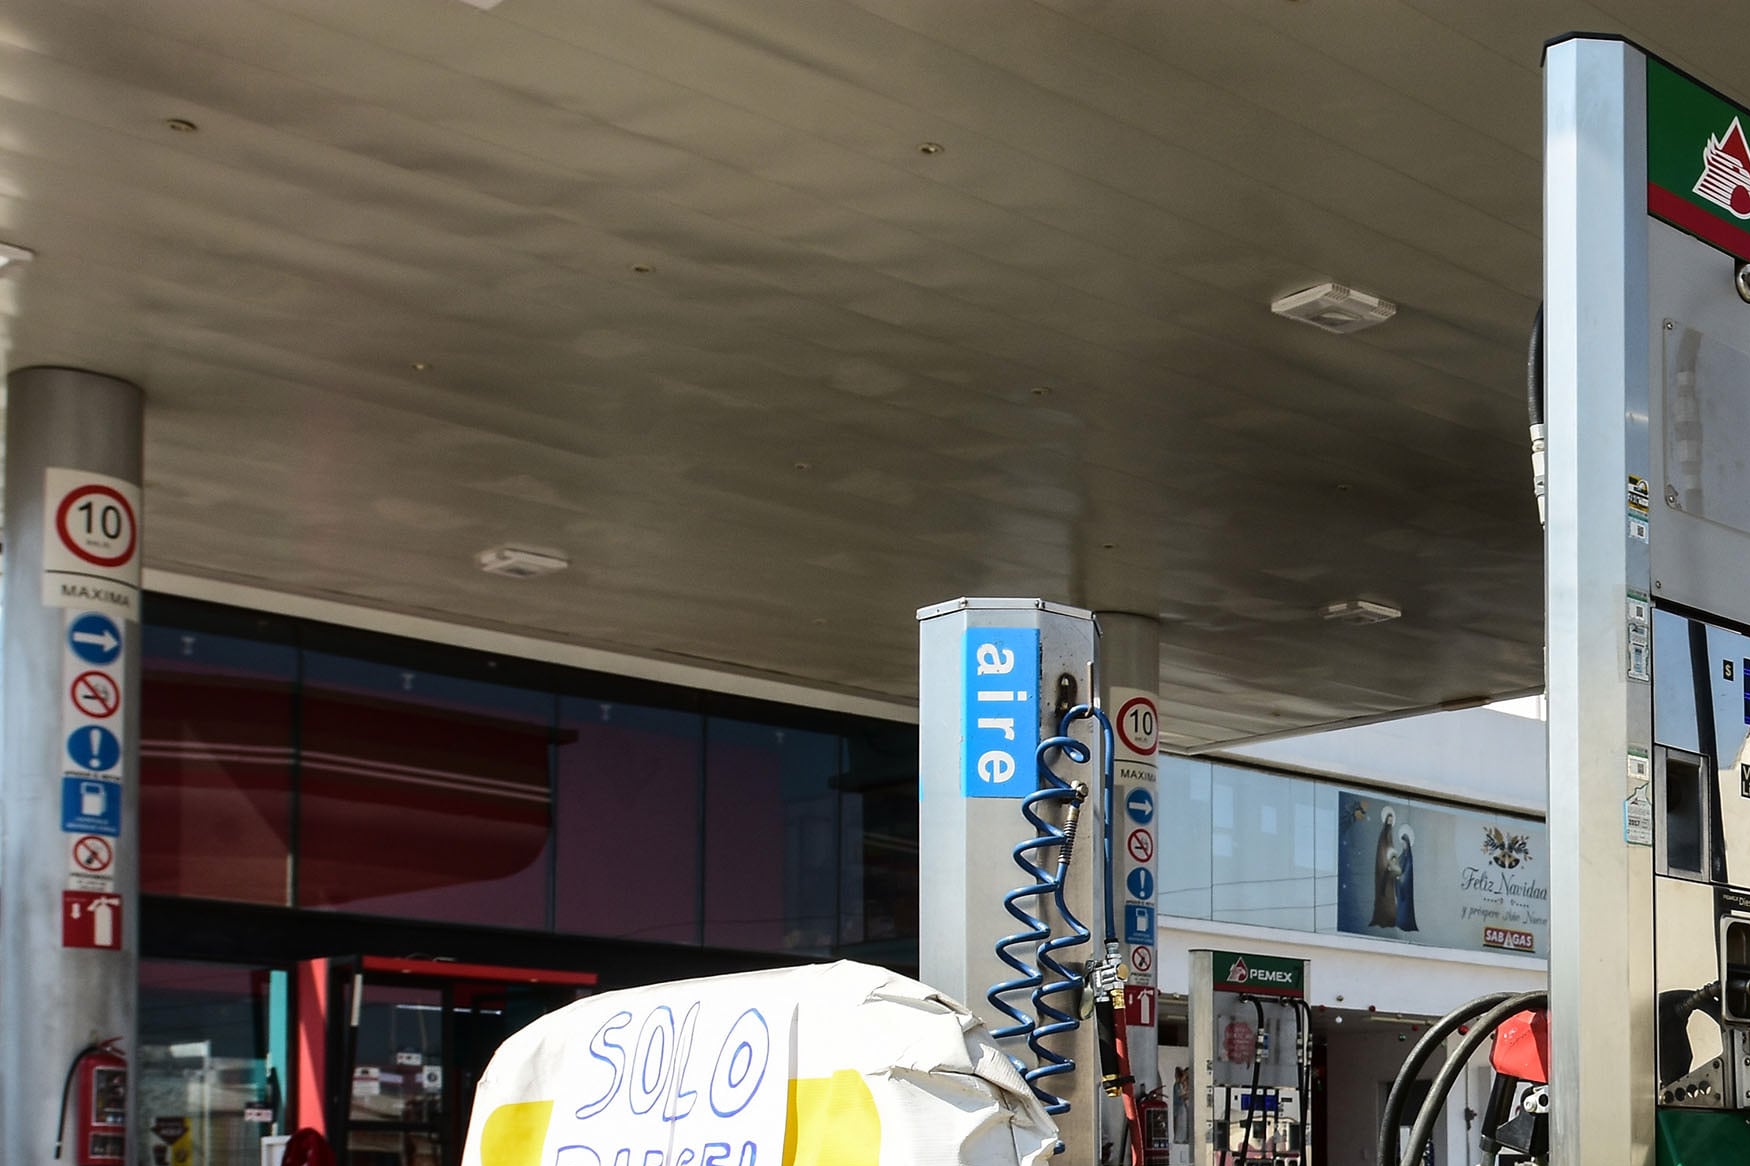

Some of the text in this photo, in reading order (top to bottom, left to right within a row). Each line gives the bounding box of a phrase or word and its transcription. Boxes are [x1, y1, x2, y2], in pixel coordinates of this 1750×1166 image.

[78, 501, 121, 539] 10
[976, 643, 1028, 783] aire
[1130, 709, 1152, 735] 10
[1460, 867, 1493, 892] Feliz
[1249, 968, 1293, 983] PEMEX
[576, 1001, 770, 1122] SOLO
